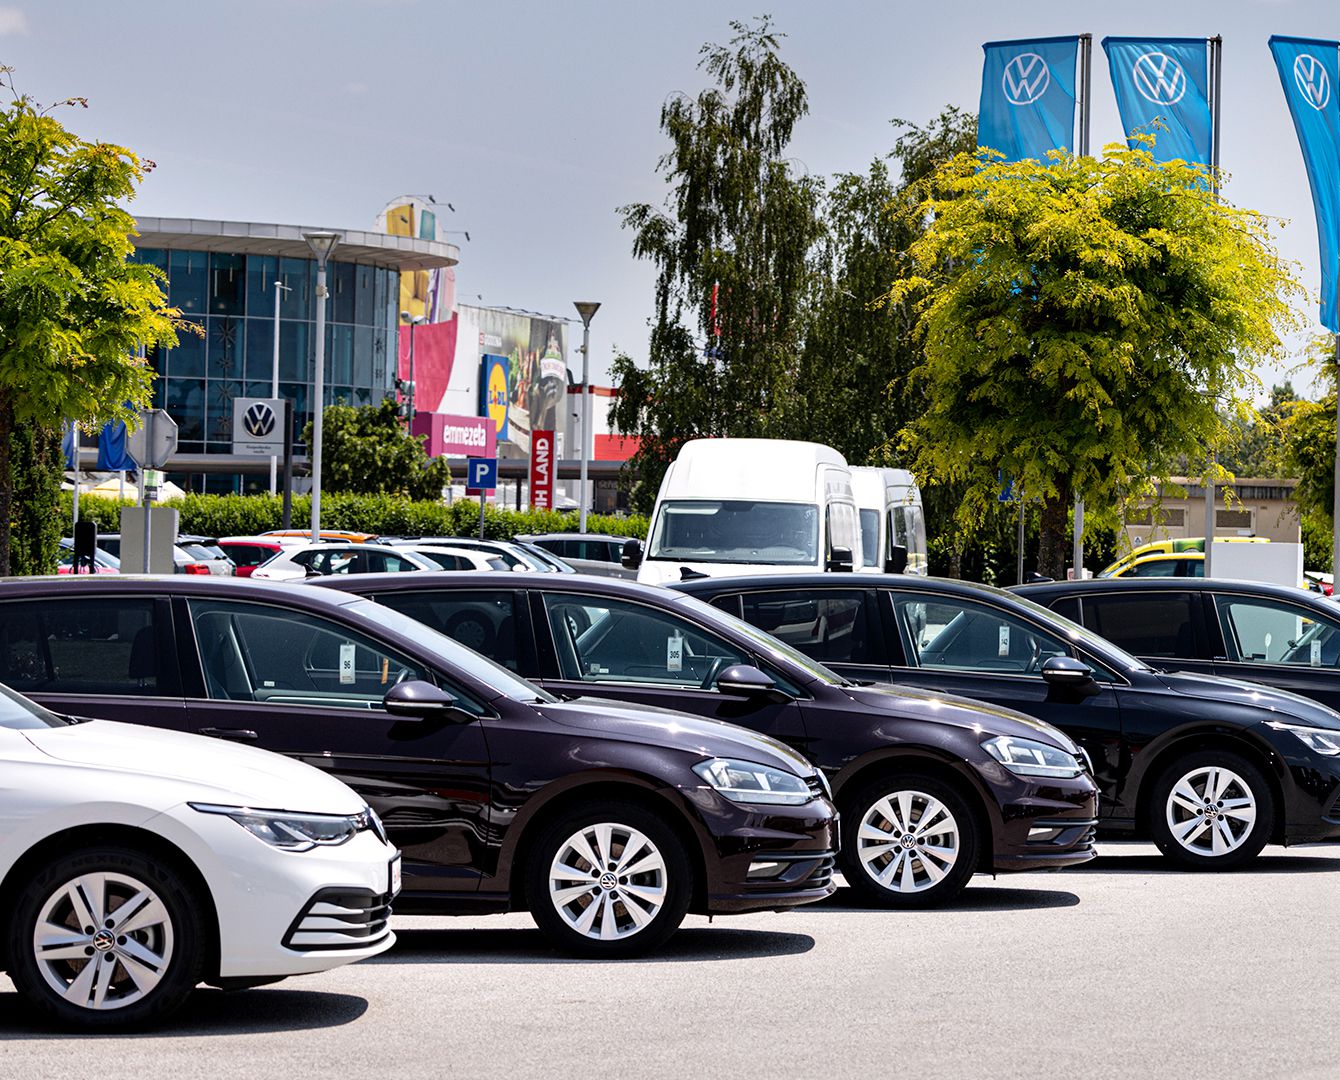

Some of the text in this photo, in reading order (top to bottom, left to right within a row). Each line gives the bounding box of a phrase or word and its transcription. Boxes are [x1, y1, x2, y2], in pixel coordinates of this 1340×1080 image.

[1003, 53, 1050, 105] VW
[1133, 52, 1186, 105] VW
[1293, 53, 1330, 110] VW
[242, 402, 277, 438] VW
[475, 464, 489, 483] P
[535, 438, 549, 486] LAND
[343, 660, 352, 670] 96
[670, 650, 680, 659] 305
